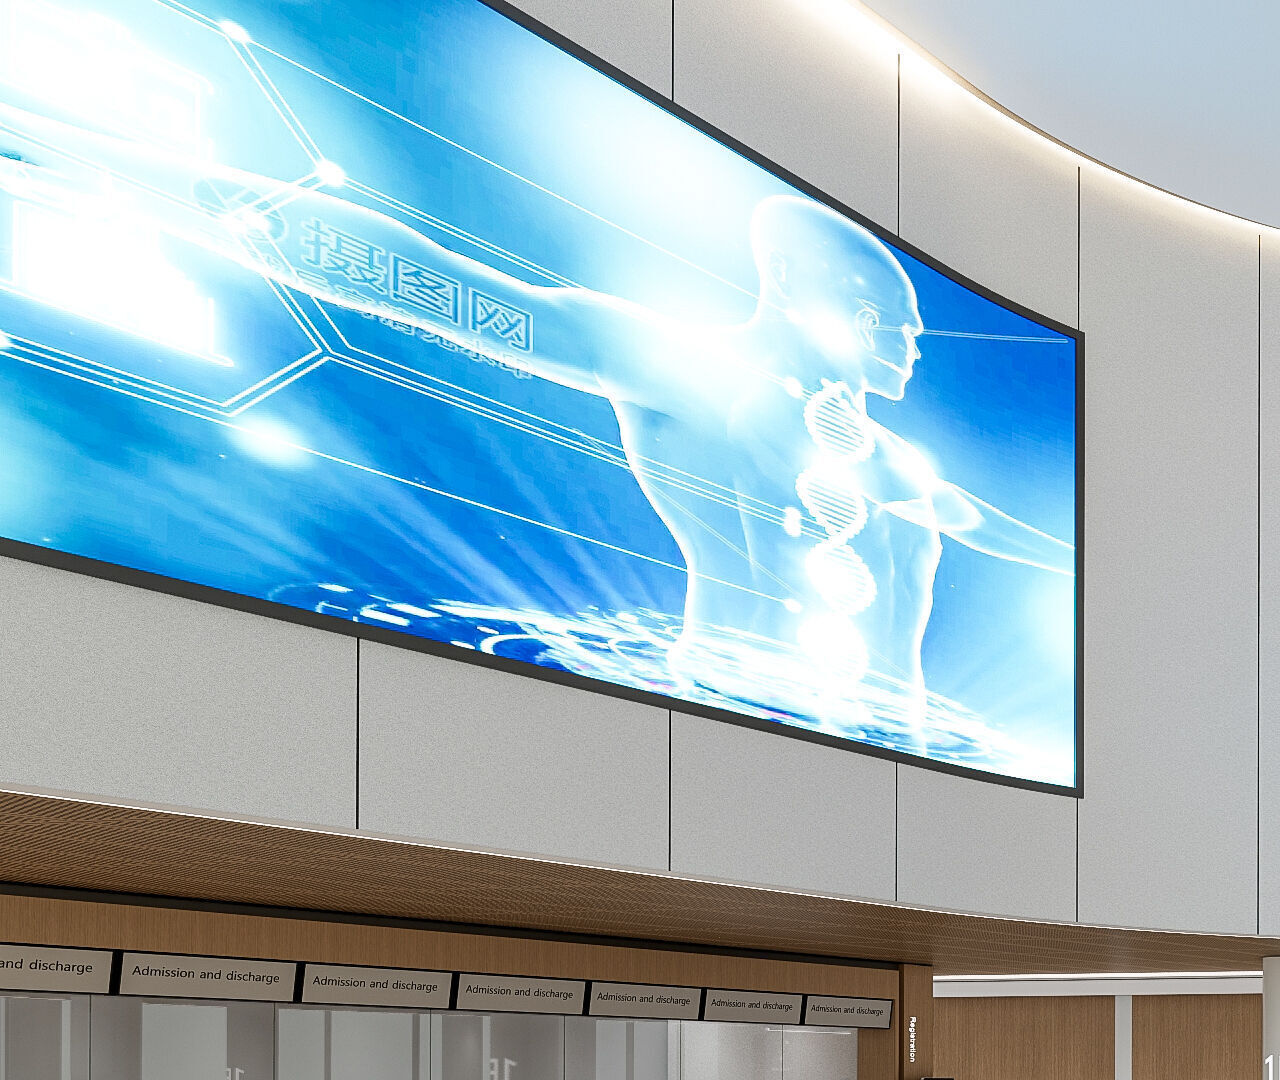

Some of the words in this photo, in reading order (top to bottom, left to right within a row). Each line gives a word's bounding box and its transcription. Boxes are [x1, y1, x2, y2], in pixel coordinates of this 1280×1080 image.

[29, 958, 93, 976] discharge
[132, 965, 195, 979] Admission
[200, 969, 222, 980] and
[226, 970, 280, 985] discharge
[312, 975, 366, 988] Admission
[370, 978, 389, 989] and
[392, 979, 438, 994] discharge
[465, 984, 512, 996] Admission
[515, 987, 531, 997] and
[534, 987, 574, 1000] discharge
[597, 991, 637, 1003] Admission
[639, 993, 654, 1003] and
[656, 994, 691, 1006] discharge
[710, 998, 746, 1009] Admission
[748, 1000, 761, 1009] and
[762, 1001, 793, 1012] discharge
[810, 1004, 842, 1014] Admission
[843, 1006, 855, 1014] and
[857, 1006, 884, 1017] discharge
